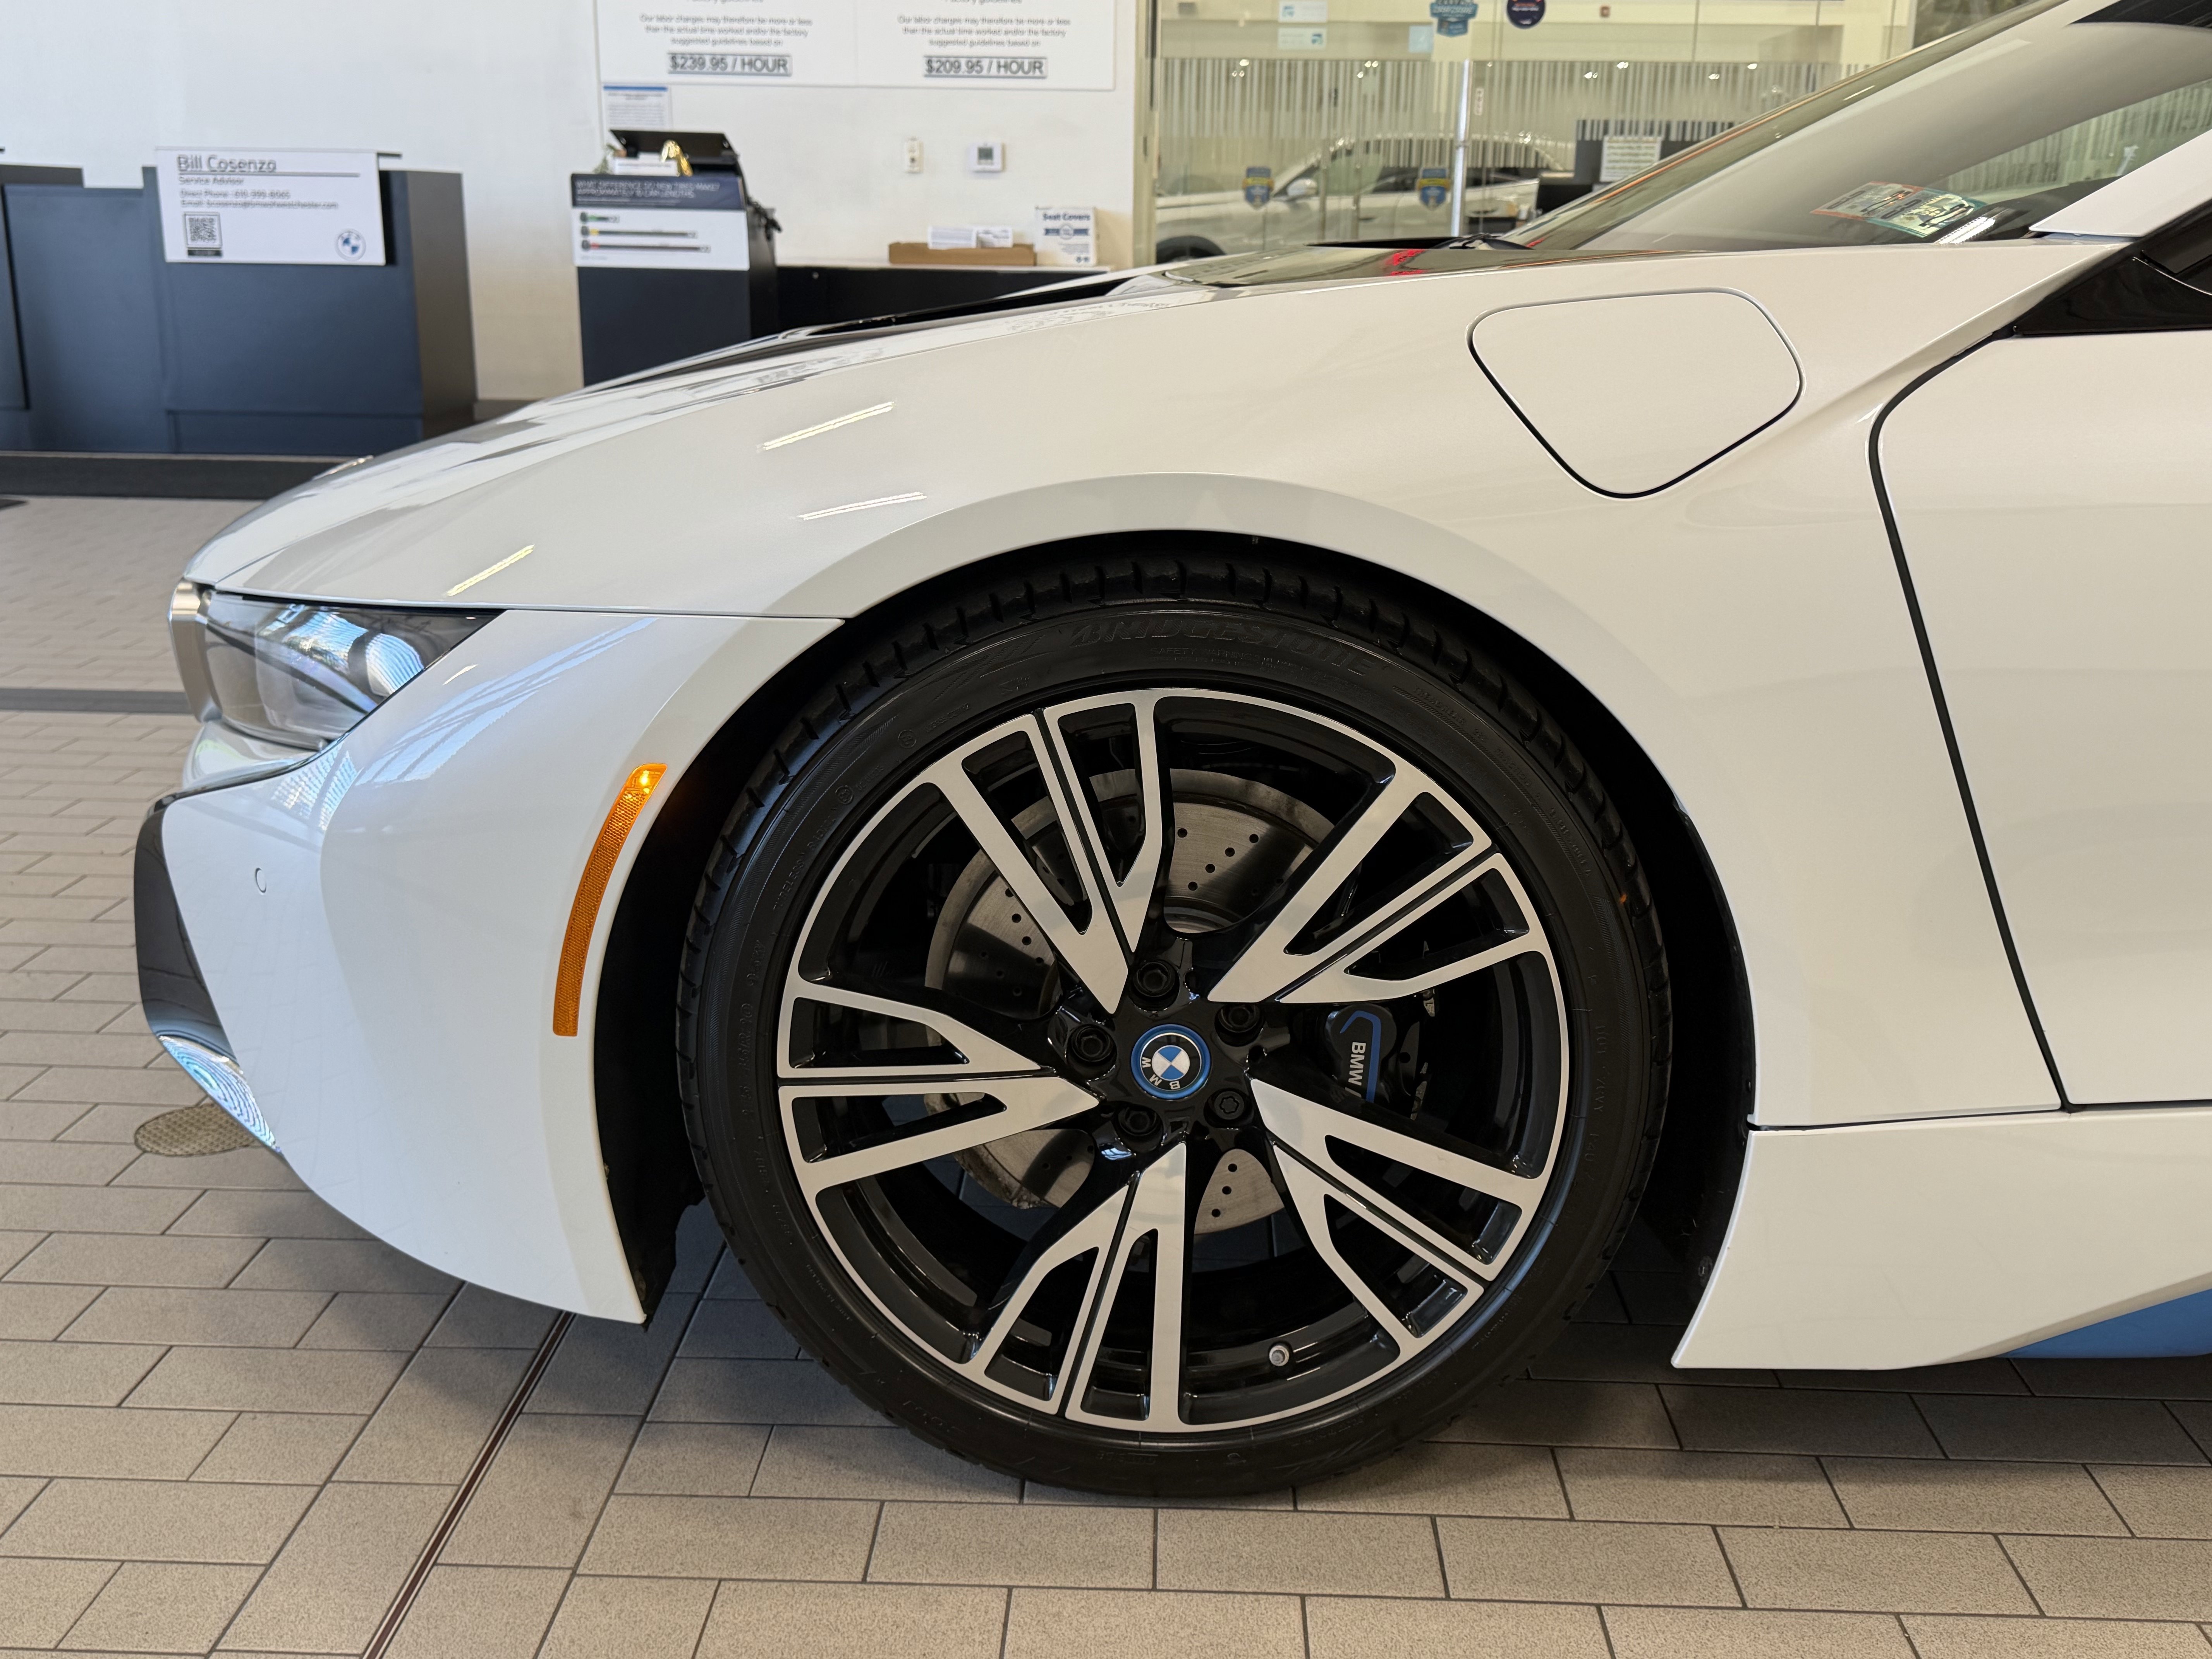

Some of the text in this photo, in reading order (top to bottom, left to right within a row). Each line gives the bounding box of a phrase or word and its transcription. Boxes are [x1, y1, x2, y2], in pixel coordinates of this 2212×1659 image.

[670, 55, 728, 71] $239.95
[741, 57, 788, 73] HOUR
[925, 58, 984, 75] $209.95
[996, 60, 1044, 76] HOUR
[177, 155, 277, 173] Bill Cosenza
[1348, 1041, 1367, 1086] BMW
